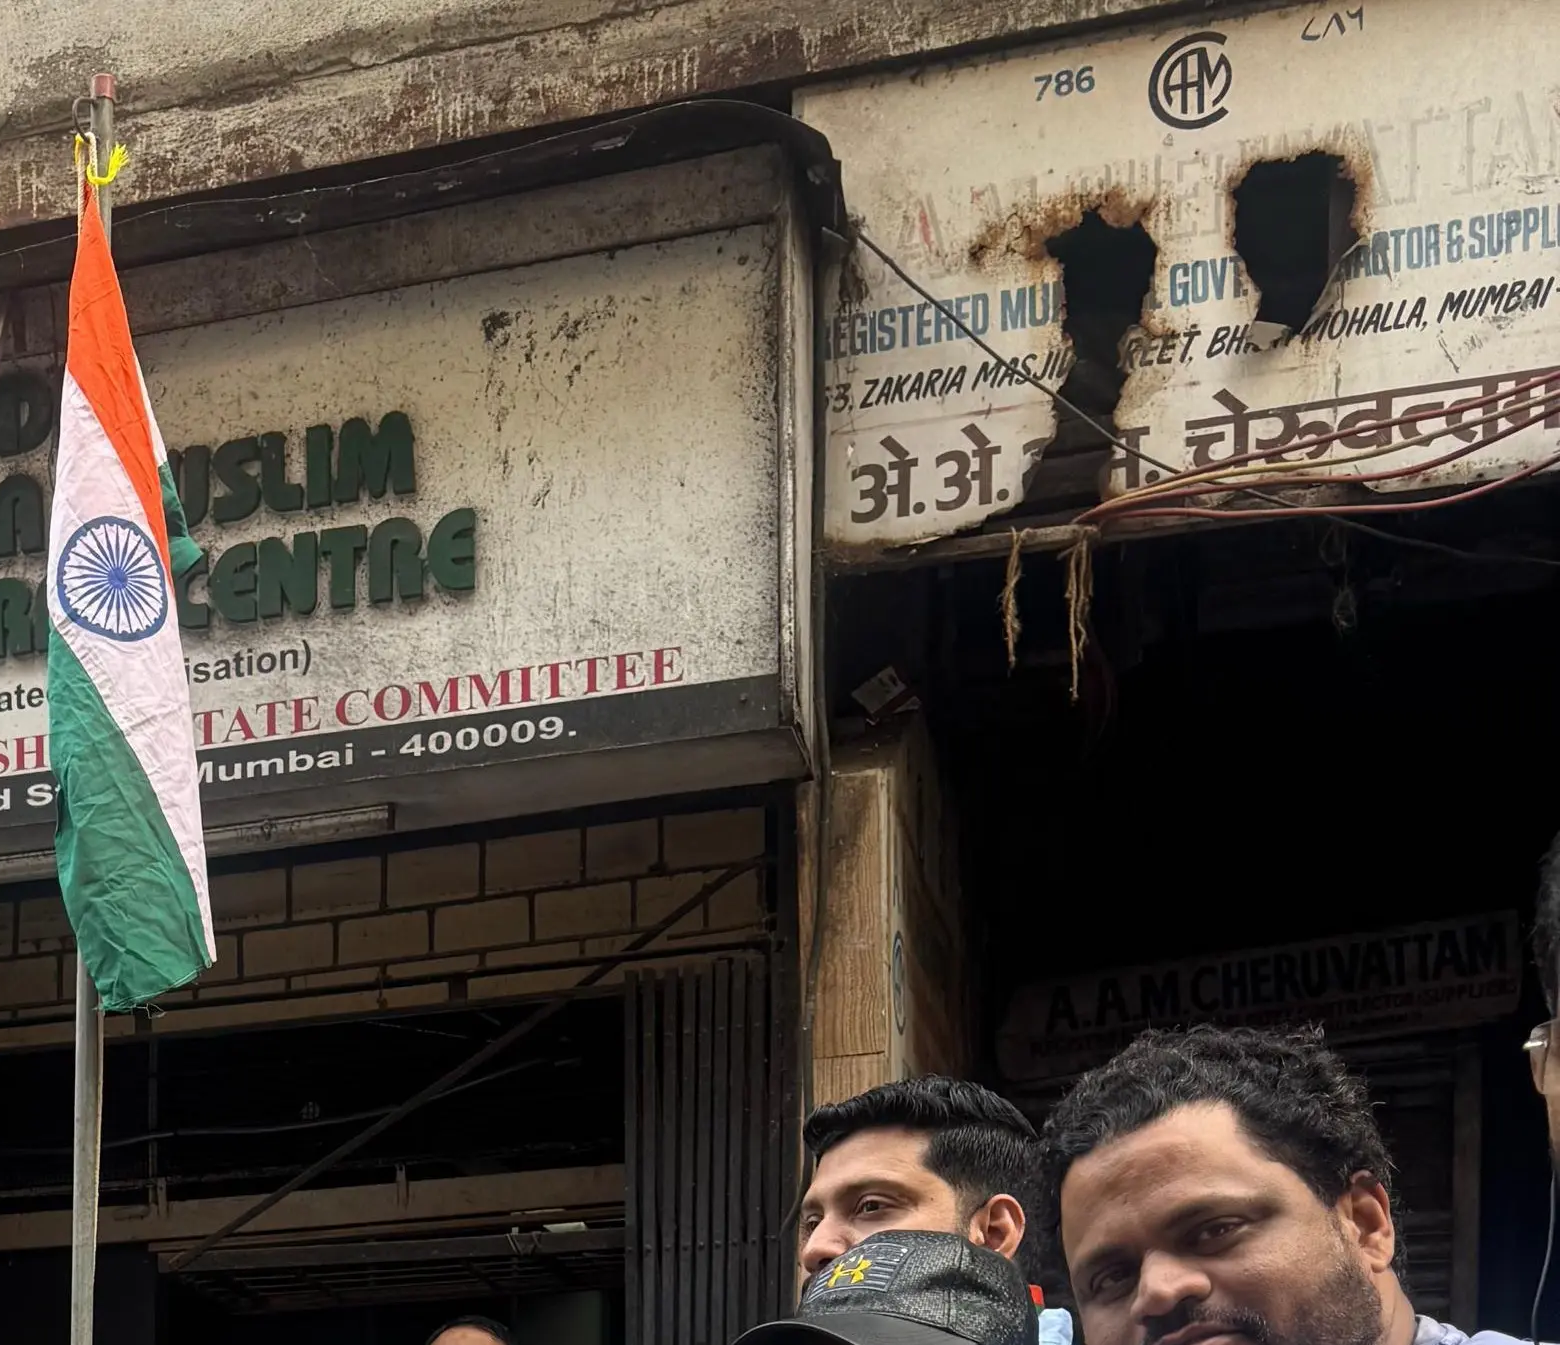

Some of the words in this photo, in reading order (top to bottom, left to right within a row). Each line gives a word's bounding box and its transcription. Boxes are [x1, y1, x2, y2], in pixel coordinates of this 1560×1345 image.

[1034, 66, 1096, 101] 786
[1447, 219, 1465, 263] &
[860, 365, 967, 409] ZAKARIA
[168, 410, 416, 529] USLIM
[175, 507, 477, 630] CENTRE
[193, 696, 323, 747] TATE
[335, 646, 685, 727] COMMITTEE
[399, 716, 577, 757] 400009.
